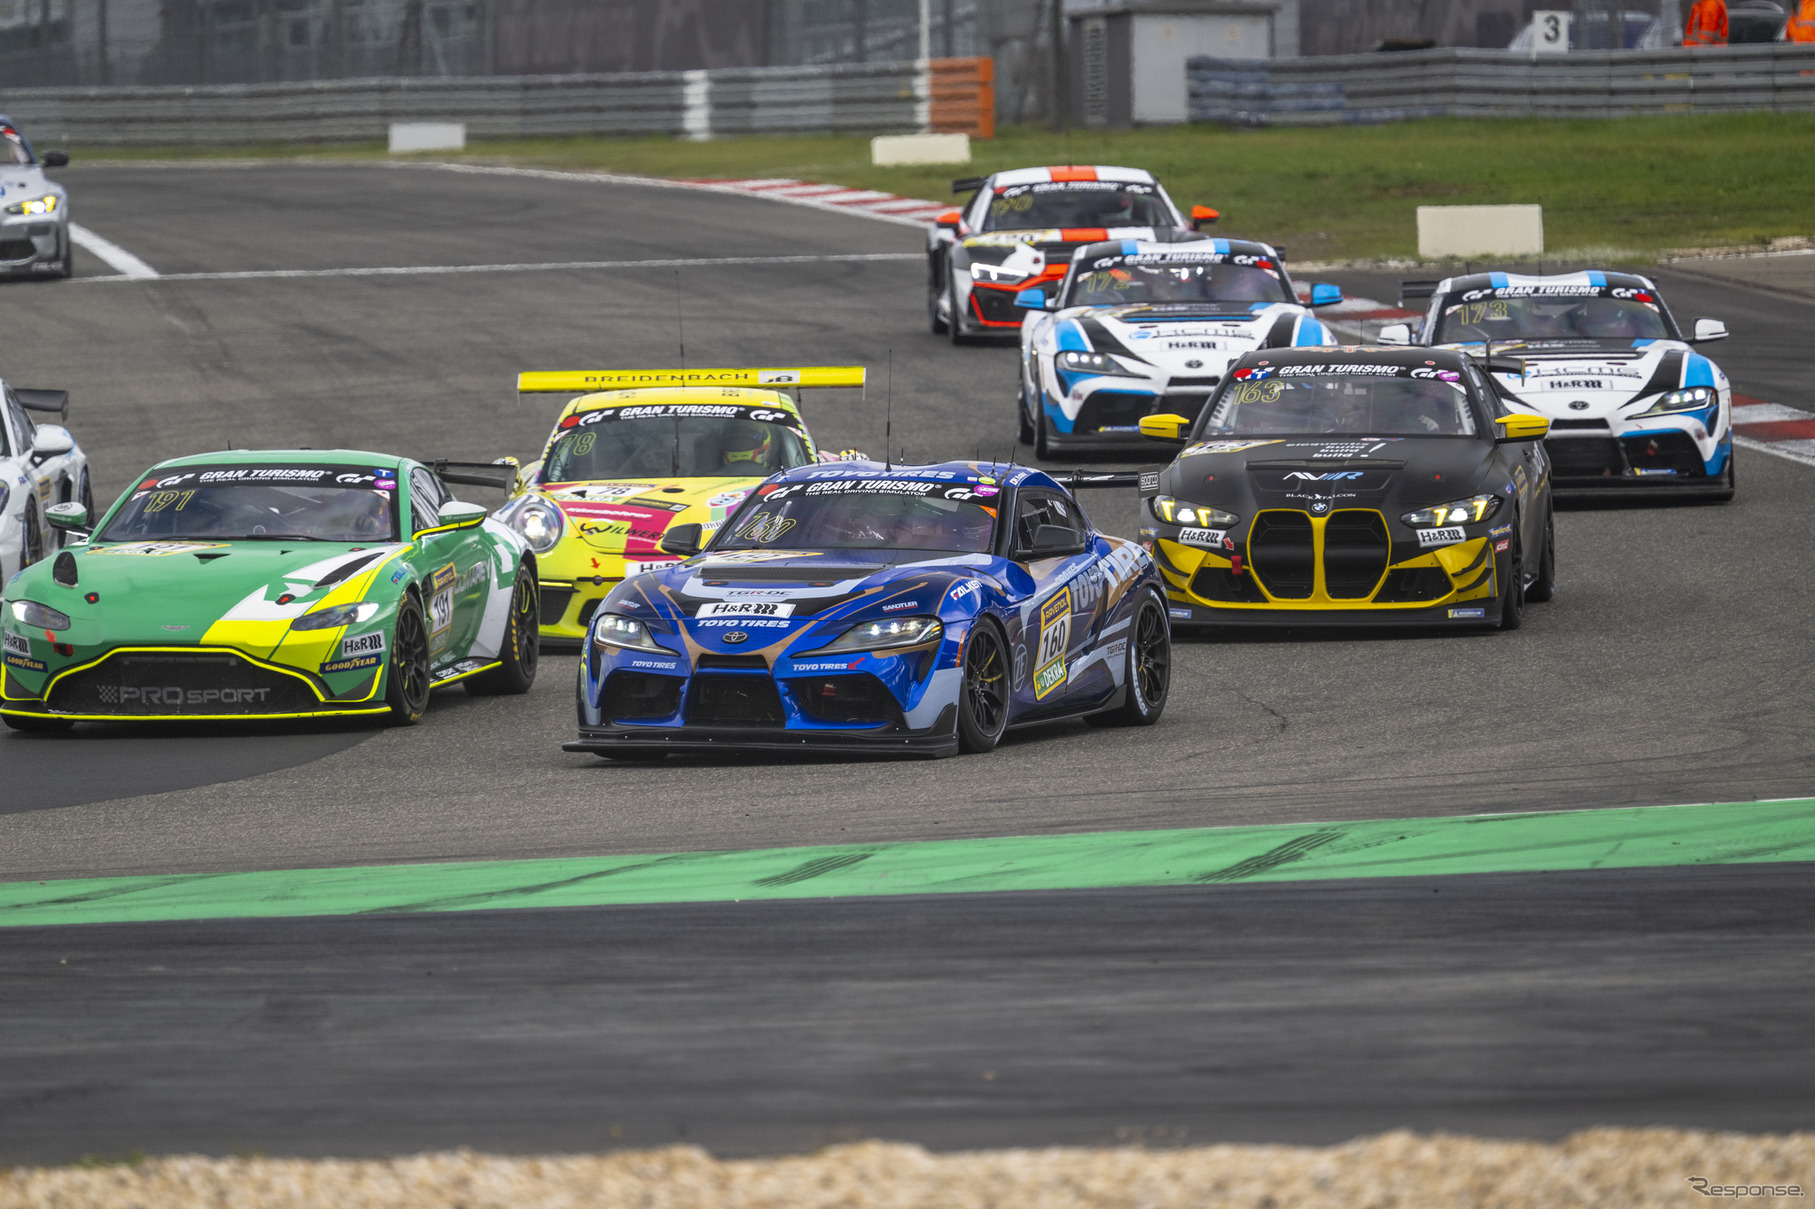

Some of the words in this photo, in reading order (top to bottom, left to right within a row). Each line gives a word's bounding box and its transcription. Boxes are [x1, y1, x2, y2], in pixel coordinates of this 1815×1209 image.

[1544, 15, 1561, 43] 3
[1124, 254, 1162, 262] GRAN
[1164, 253, 1224, 261] TURISMO
[1495, 287, 1535, 295] GRAN
[1537, 286, 1600, 294] TURISMO
[1457, 300, 1507, 325] 173
[1279, 365, 1325, 374] GRAN
[1327, 365, 1399, 373] TURISMO
[585, 373, 748, 383] BREIDENBACH
[1233, 380, 1282, 405] 163
[619, 406, 665, 417] GRAN
[667, 405, 739, 416] TURISMO
[199, 470, 249, 480] GRAN
[251, 470, 325, 478] TURISMO
[807, 470, 880, 479] TOYO
[881, 471, 956, 479] TIRES
[1141, 474, 1158, 486] sparco
[597, 487, 631, 496] 78
[806, 480, 856, 494] GRAN
[857, 479, 936, 493] TURISMO
[879, 489, 927, 497] SIMULATOR
[144, 490, 195, 512] 191
[735, 511, 798, 544] 160
[950, 580, 983, 600] FALKEN
[434, 586, 450, 622] 191
[712, 604, 753, 615] H&R
[882, 601, 918, 611] SANDTLER
[1045, 598, 1067, 620] RAVENOL
[697, 620, 739, 628] TOYO
[740, 620, 791, 629] TIRES
[1043, 620, 1066, 664] 160
[7, 656, 44, 670] GOODYEAR
[325, 657, 377, 672] GOODYEAR
[652, 662, 676, 670] TIRES
[793, 663, 818, 671] TOYO
[819, 663, 848, 671] TIRES
[1043, 662, 1064, 683] DEKRA
[120, 686, 183, 704] PRO
[187, 687, 270, 704] SPORT
